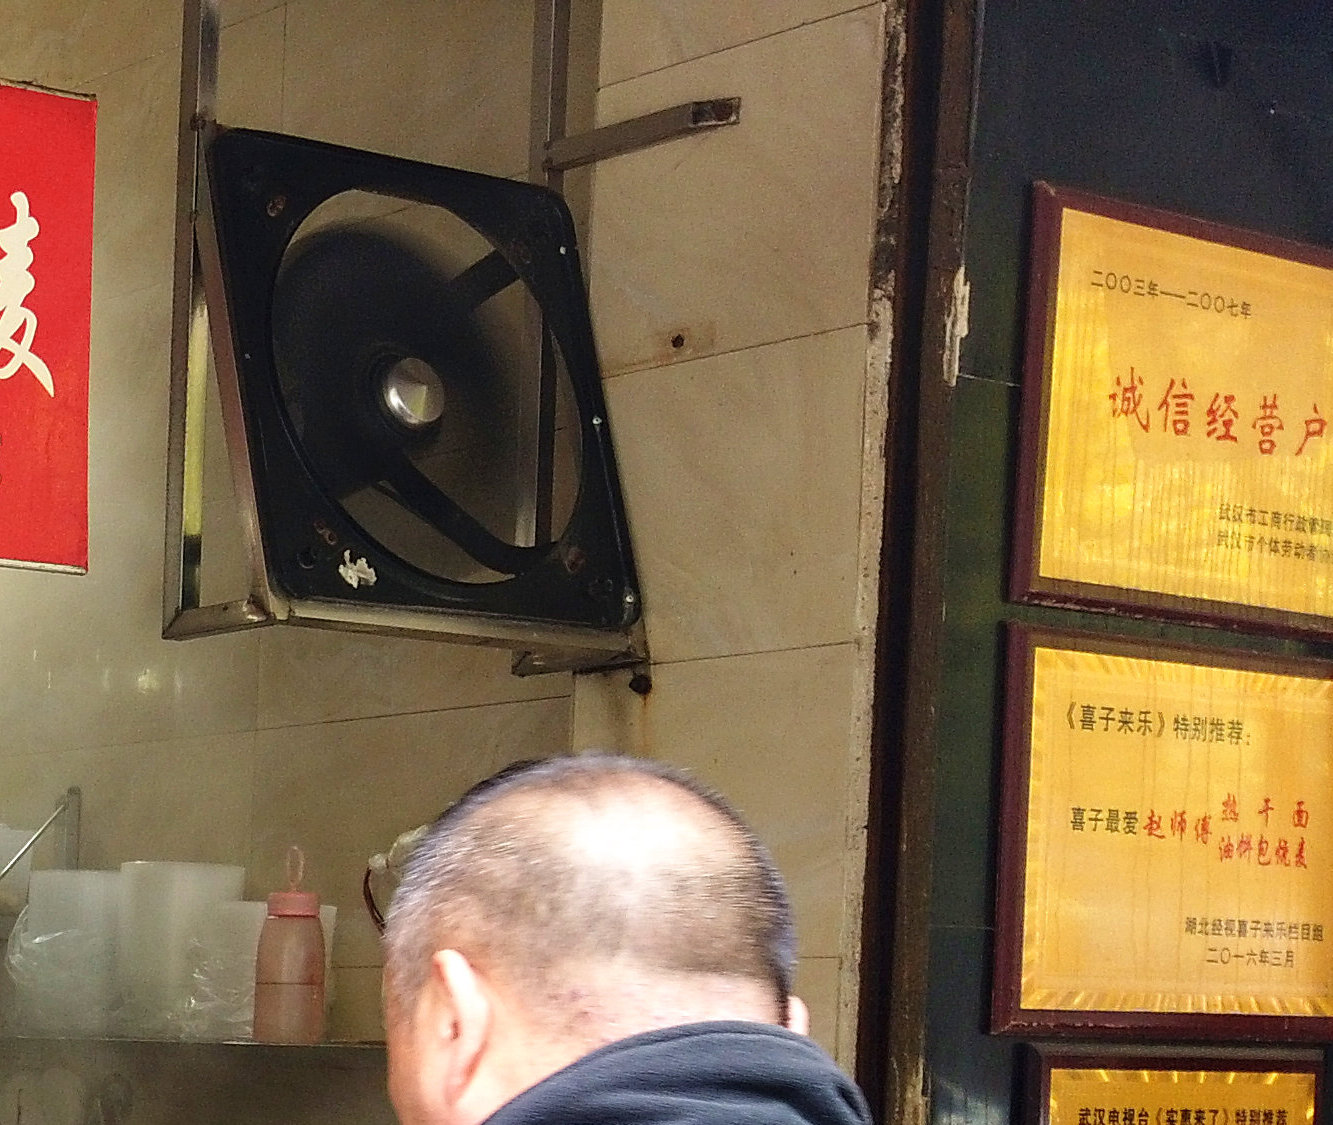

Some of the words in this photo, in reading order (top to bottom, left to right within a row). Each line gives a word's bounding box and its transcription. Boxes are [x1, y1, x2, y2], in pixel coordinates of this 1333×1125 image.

[1108, 366, 1329, 457] 诚信经营户
[1070, 806, 1139, 836] 喜子最爱
